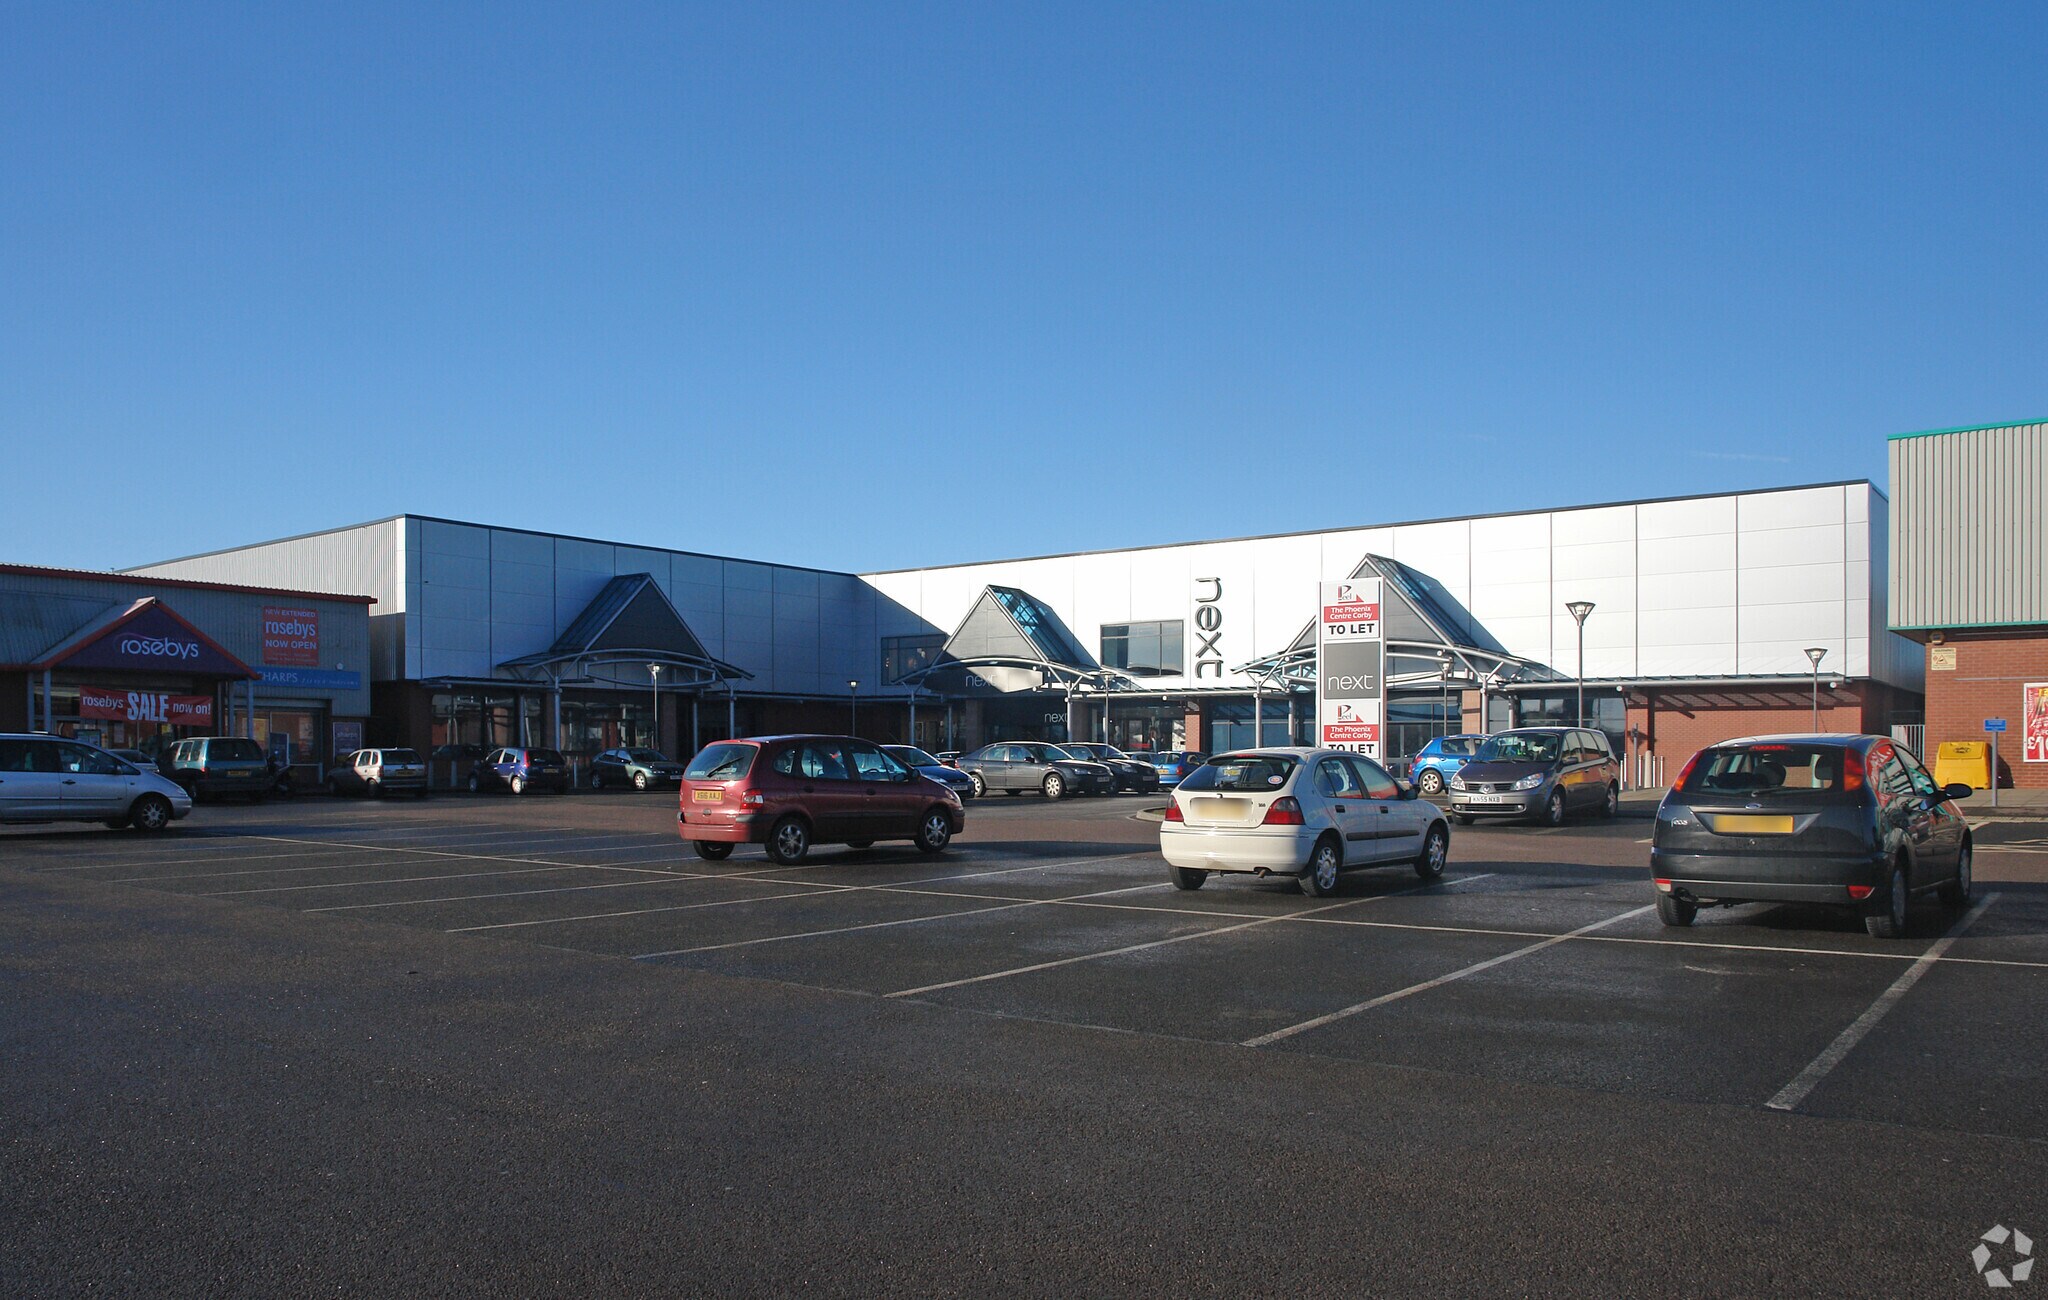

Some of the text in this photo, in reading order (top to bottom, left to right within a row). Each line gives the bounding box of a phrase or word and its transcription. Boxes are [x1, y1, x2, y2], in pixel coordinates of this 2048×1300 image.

[281, 610, 316, 618] EXTENDED
[1344, 605, 1371, 613] Phoenix
[265, 619, 316, 639] rosebys
[1195, 577, 1223, 679] next
[1328, 623, 1375, 635] TO LET
[121, 637, 199, 660] rosebys
[265, 640, 317, 650] NOW OPEN
[1328, 674, 1374, 691] next
[82, 691, 211, 722] rosebys SALE now on!
[1350, 744, 1375, 753] LET
[2028, 736, 2048, 760] £1
